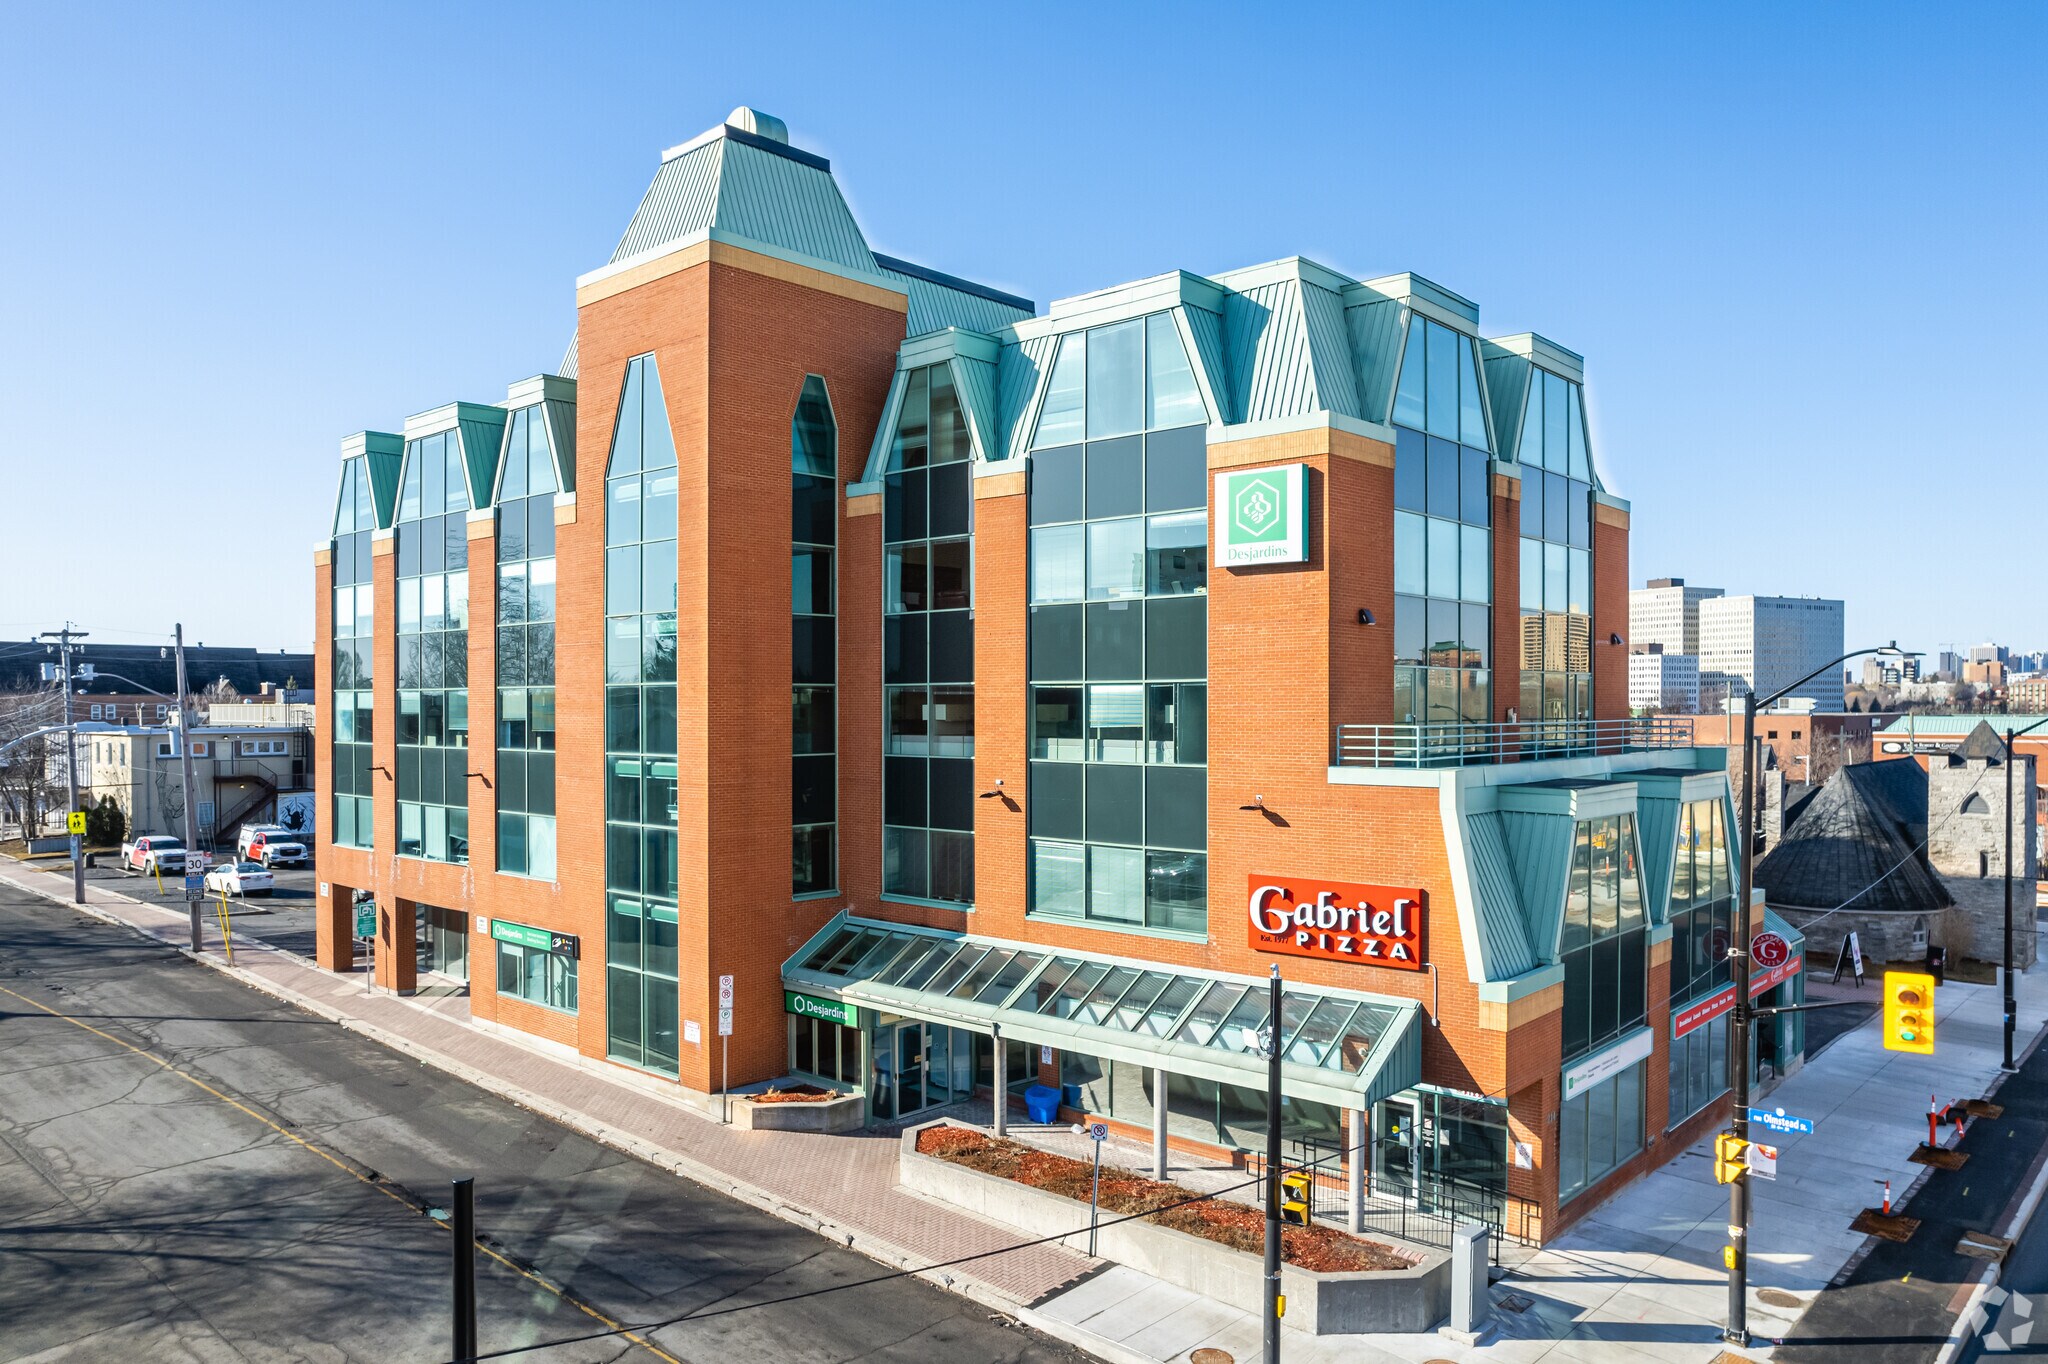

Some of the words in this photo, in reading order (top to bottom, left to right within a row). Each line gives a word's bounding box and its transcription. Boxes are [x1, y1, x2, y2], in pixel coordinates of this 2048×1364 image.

[1228, 545, 1288, 562] Desjardins
[188, 859, 202, 870] 30
[1249, 885, 1411, 938] Gabriel
[1295, 931, 1409, 960] PIZZA
[1760, 941, 1779, 959] G
[807, 1001, 849, 1021] Desjardins
[1763, 1113, 1800, 1130] Olmstead
